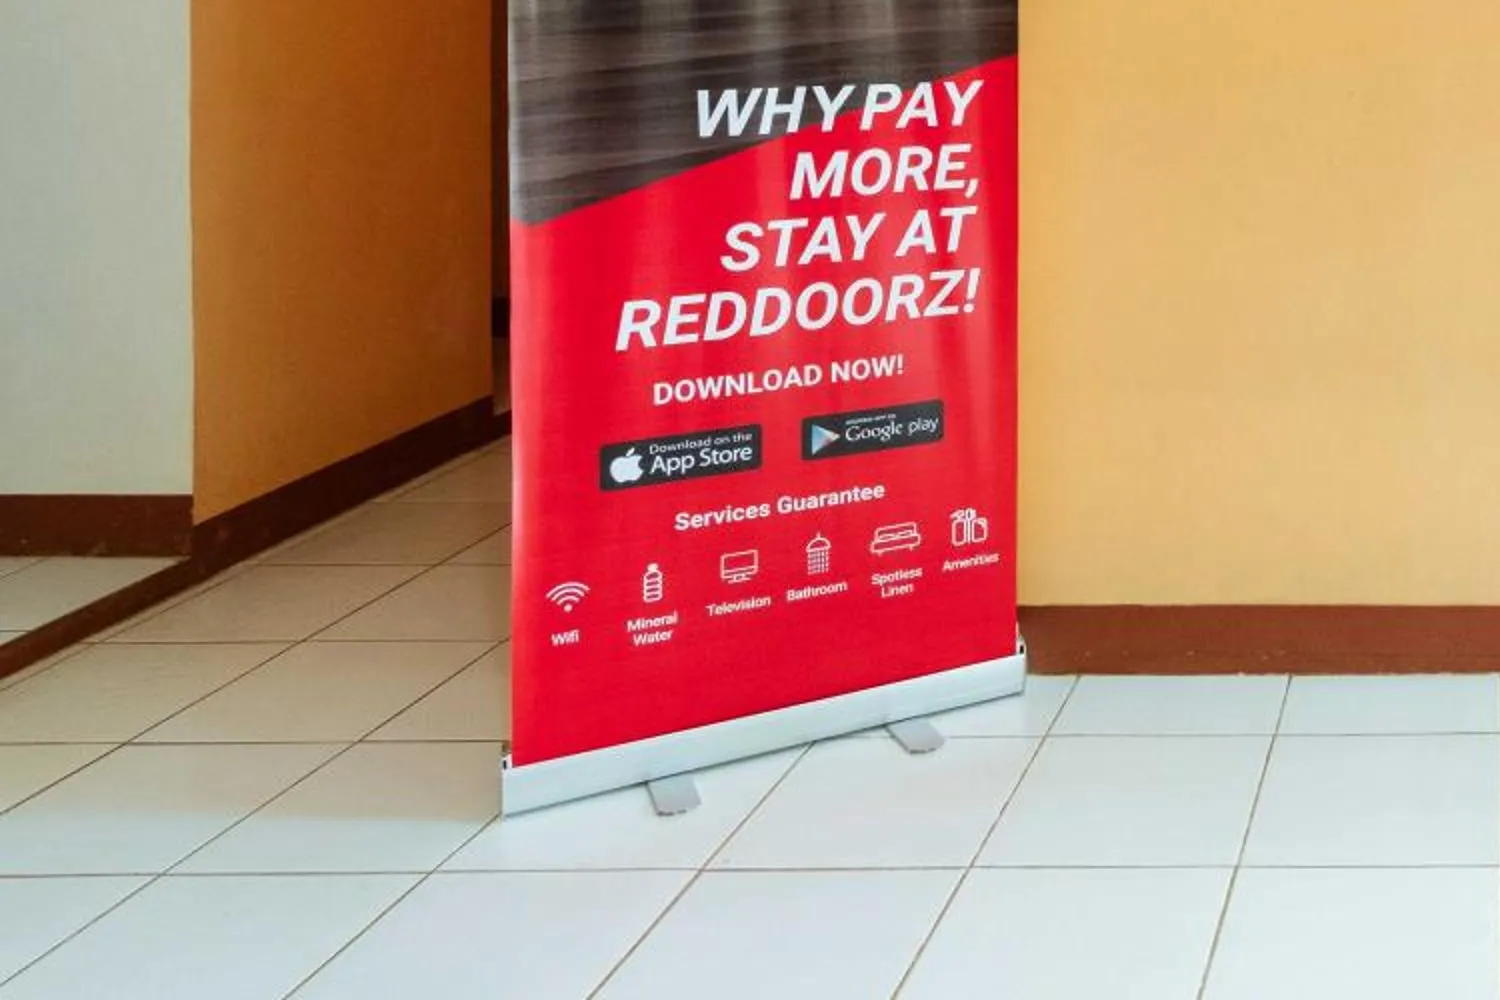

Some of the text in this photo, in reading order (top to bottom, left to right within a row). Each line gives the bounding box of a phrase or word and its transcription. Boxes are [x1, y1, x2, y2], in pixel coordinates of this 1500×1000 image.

[697, 79, 985, 139] WHY PAY
[789, 143, 981, 200] MORE,
[720, 205, 978, 273] STAY AT
[615, 267, 982, 351] REDDOORZ!
[653, 353, 904, 406] DOWNLOAD NOW!
[844, 417, 940, 442] Google play
[649, 431, 753, 455] Download on the
[649, 446, 753, 477] App Store
[674, 484, 886, 532] Services Guarantee
[942, 552, 1001, 572] Amenities
[871, 567, 923, 586] Spotless
[783, 581, 848, 602] Bathroom
[881, 583, 914, 599] Linen
[705, 596, 772, 617] Television
[627, 611, 678, 632] Mineral
[552, 629, 580, 647] Wifi
[634, 630, 674, 647] Water
